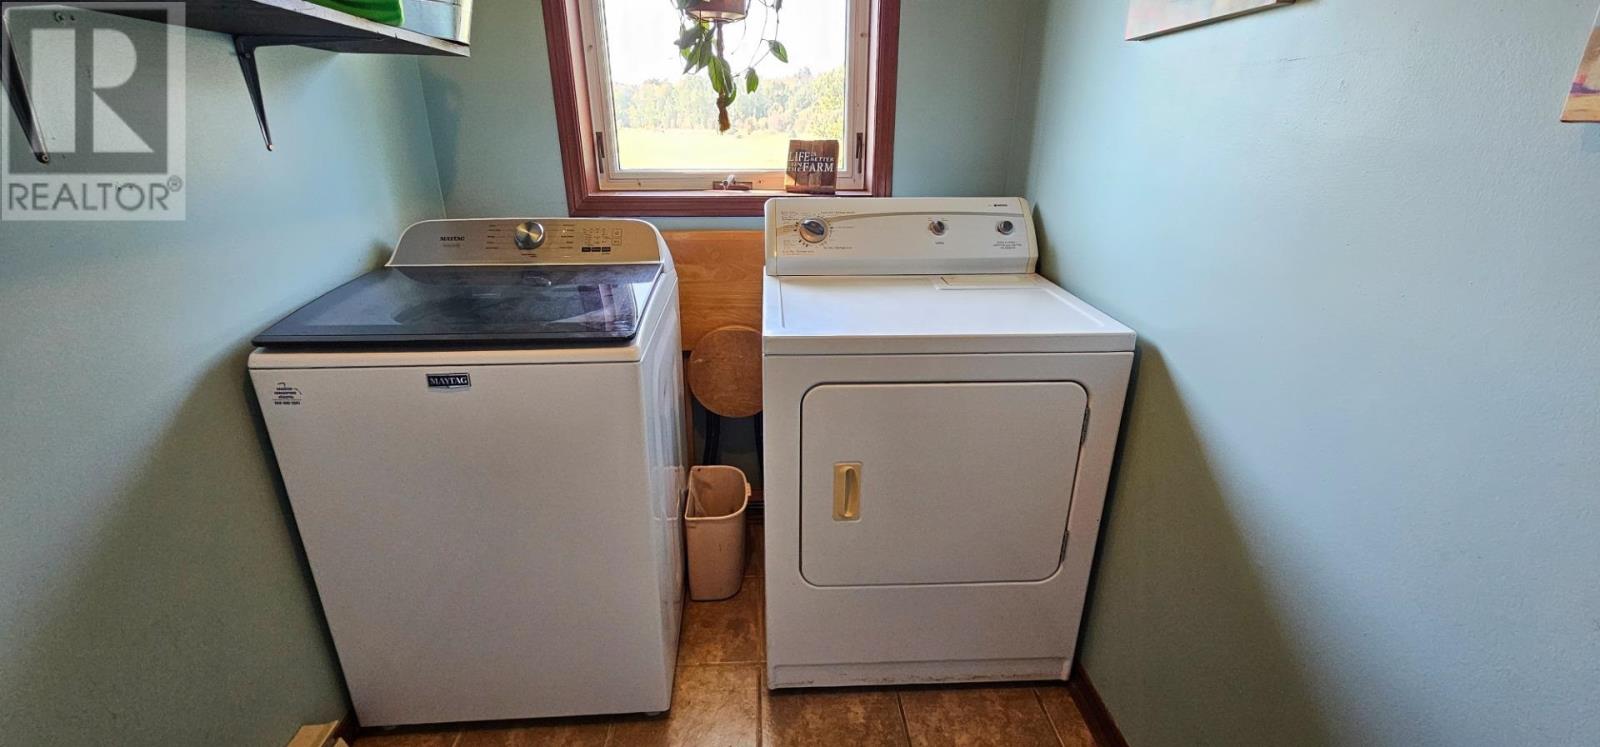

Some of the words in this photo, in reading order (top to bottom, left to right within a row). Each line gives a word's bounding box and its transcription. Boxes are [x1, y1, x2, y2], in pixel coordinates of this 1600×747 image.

[788, 151, 810, 162] LIFE
[803, 162, 834, 172] FARM
[429, 377, 468, 385] MAYTAG
